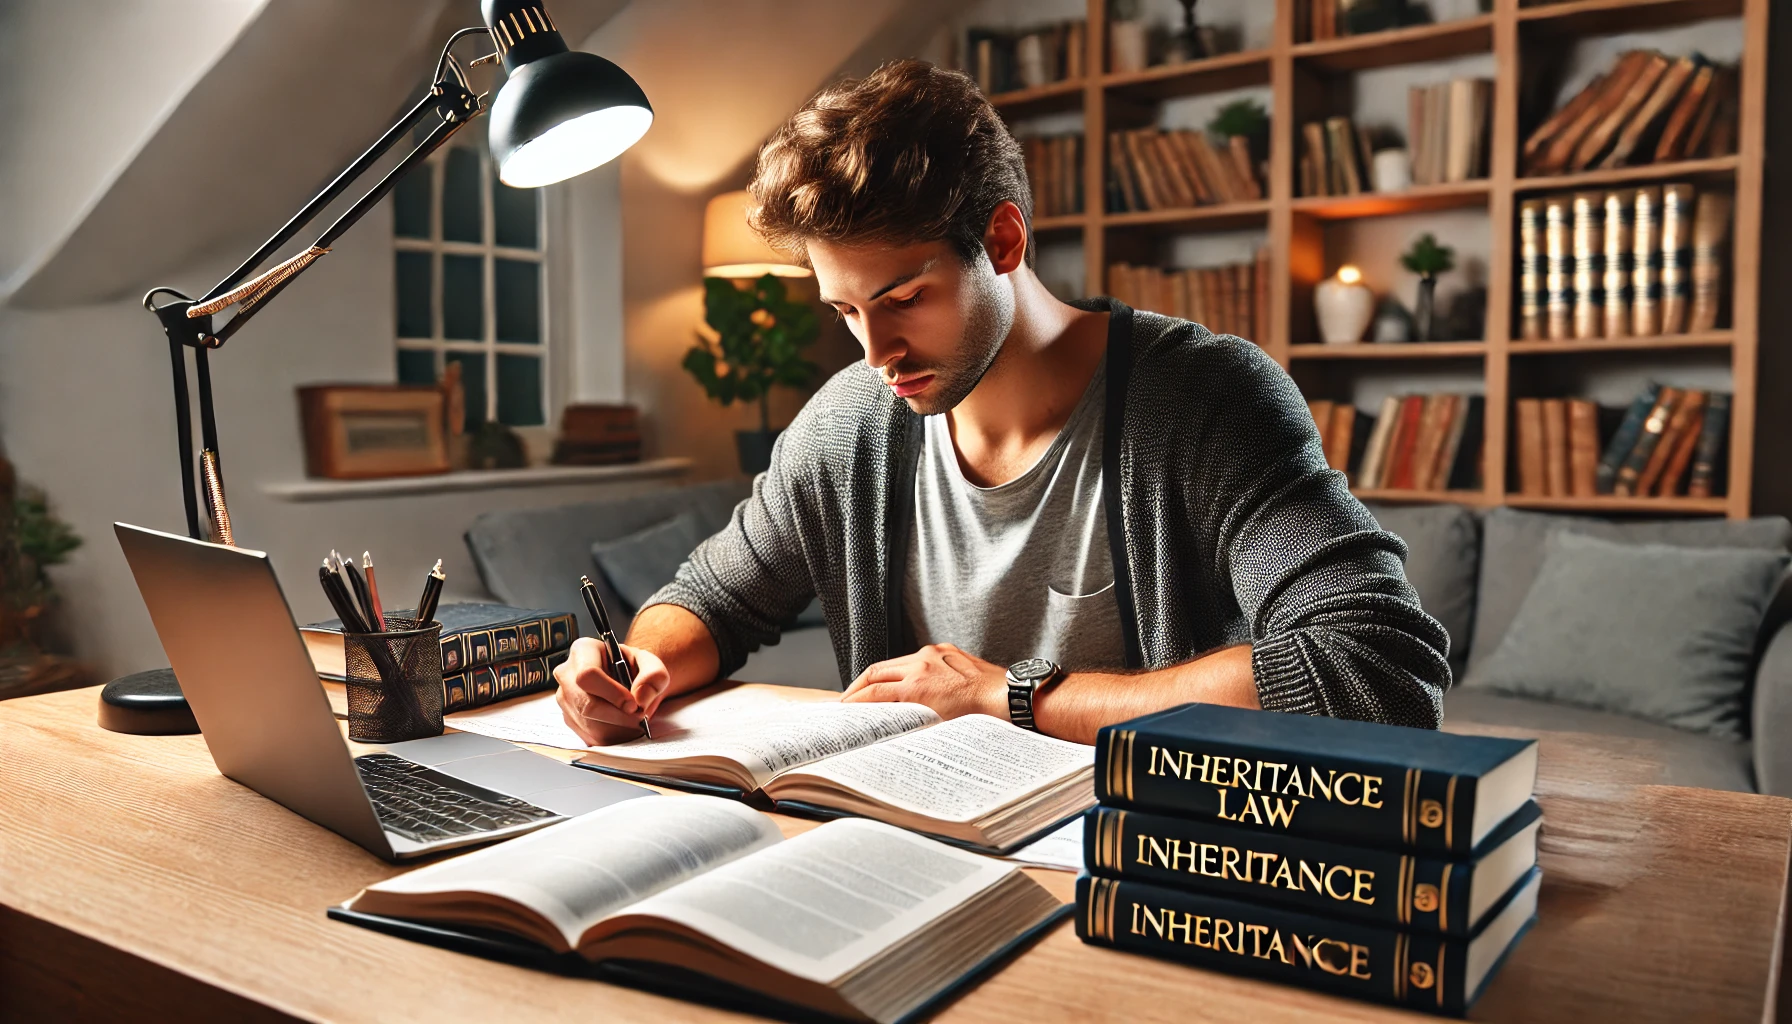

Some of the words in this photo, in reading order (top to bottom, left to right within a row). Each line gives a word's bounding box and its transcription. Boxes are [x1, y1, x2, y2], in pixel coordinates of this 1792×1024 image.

[1148, 746, 1383, 809] INHERITANCE
[1218, 789, 1299, 828] LAW
[1137, 835, 1375, 905] INHERITANCE
[1131, 903, 1372, 980] INHERITANCE
